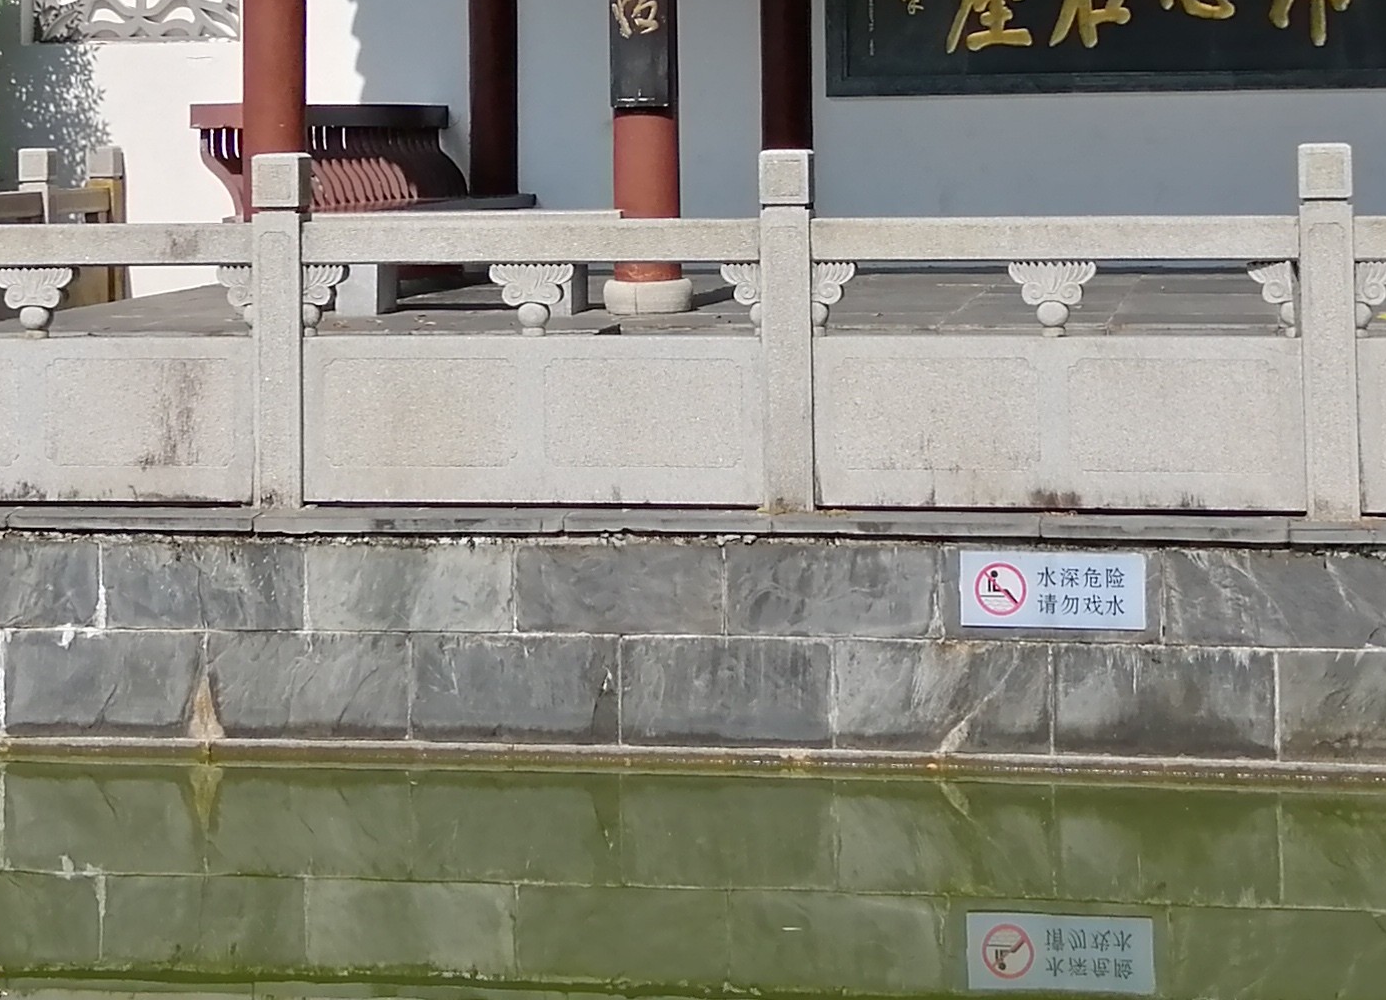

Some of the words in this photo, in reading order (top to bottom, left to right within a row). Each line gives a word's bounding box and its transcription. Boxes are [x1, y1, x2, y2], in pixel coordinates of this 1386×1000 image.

[1037, 566, 1126, 589] 水深危险
[1037, 593, 1126, 616] 请勿戏水
